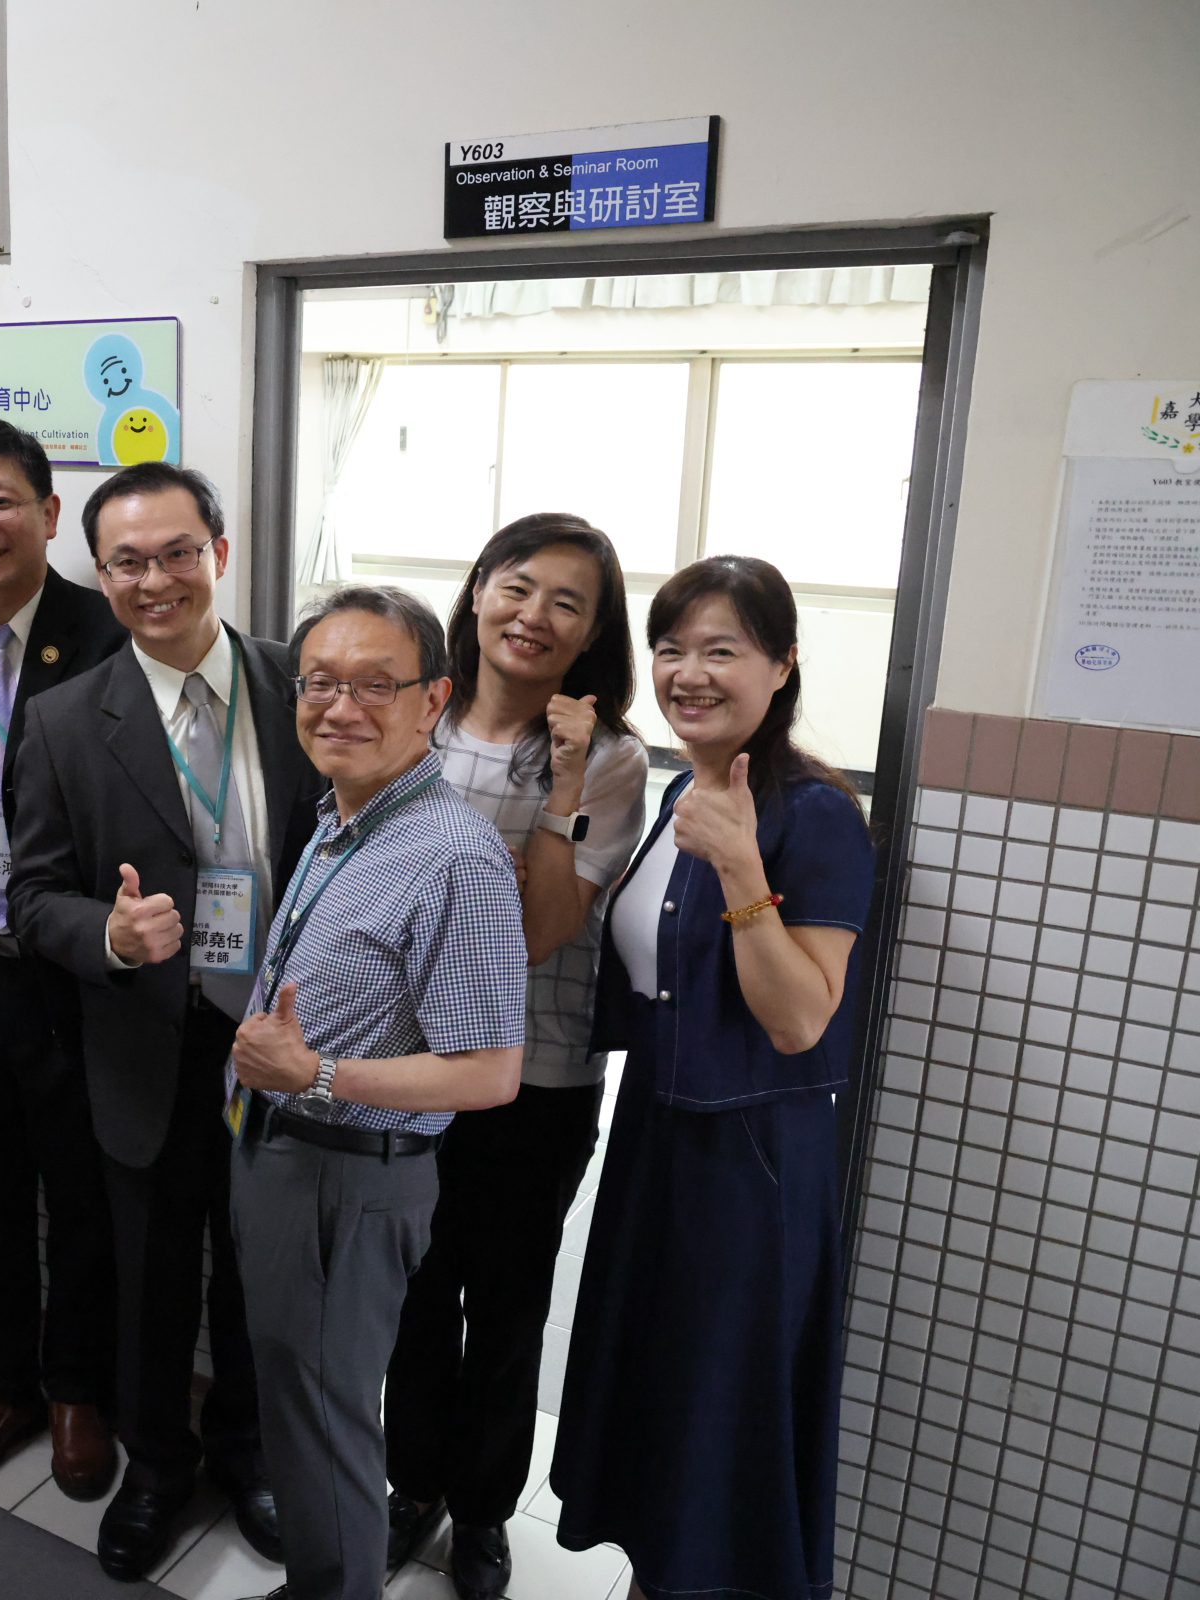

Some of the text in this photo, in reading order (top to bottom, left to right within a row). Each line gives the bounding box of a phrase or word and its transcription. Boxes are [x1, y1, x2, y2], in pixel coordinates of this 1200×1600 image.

[460, 143, 504, 161] Y603
[456, 156, 659, 185] Observation & Seminar Room
[484, 180, 700, 231] 觀察與研討室
[1160, 400, 1179, 420] 嘉
[41, 429, 89, 439] Cultivation
[204, 951, 230, 964] 老師
